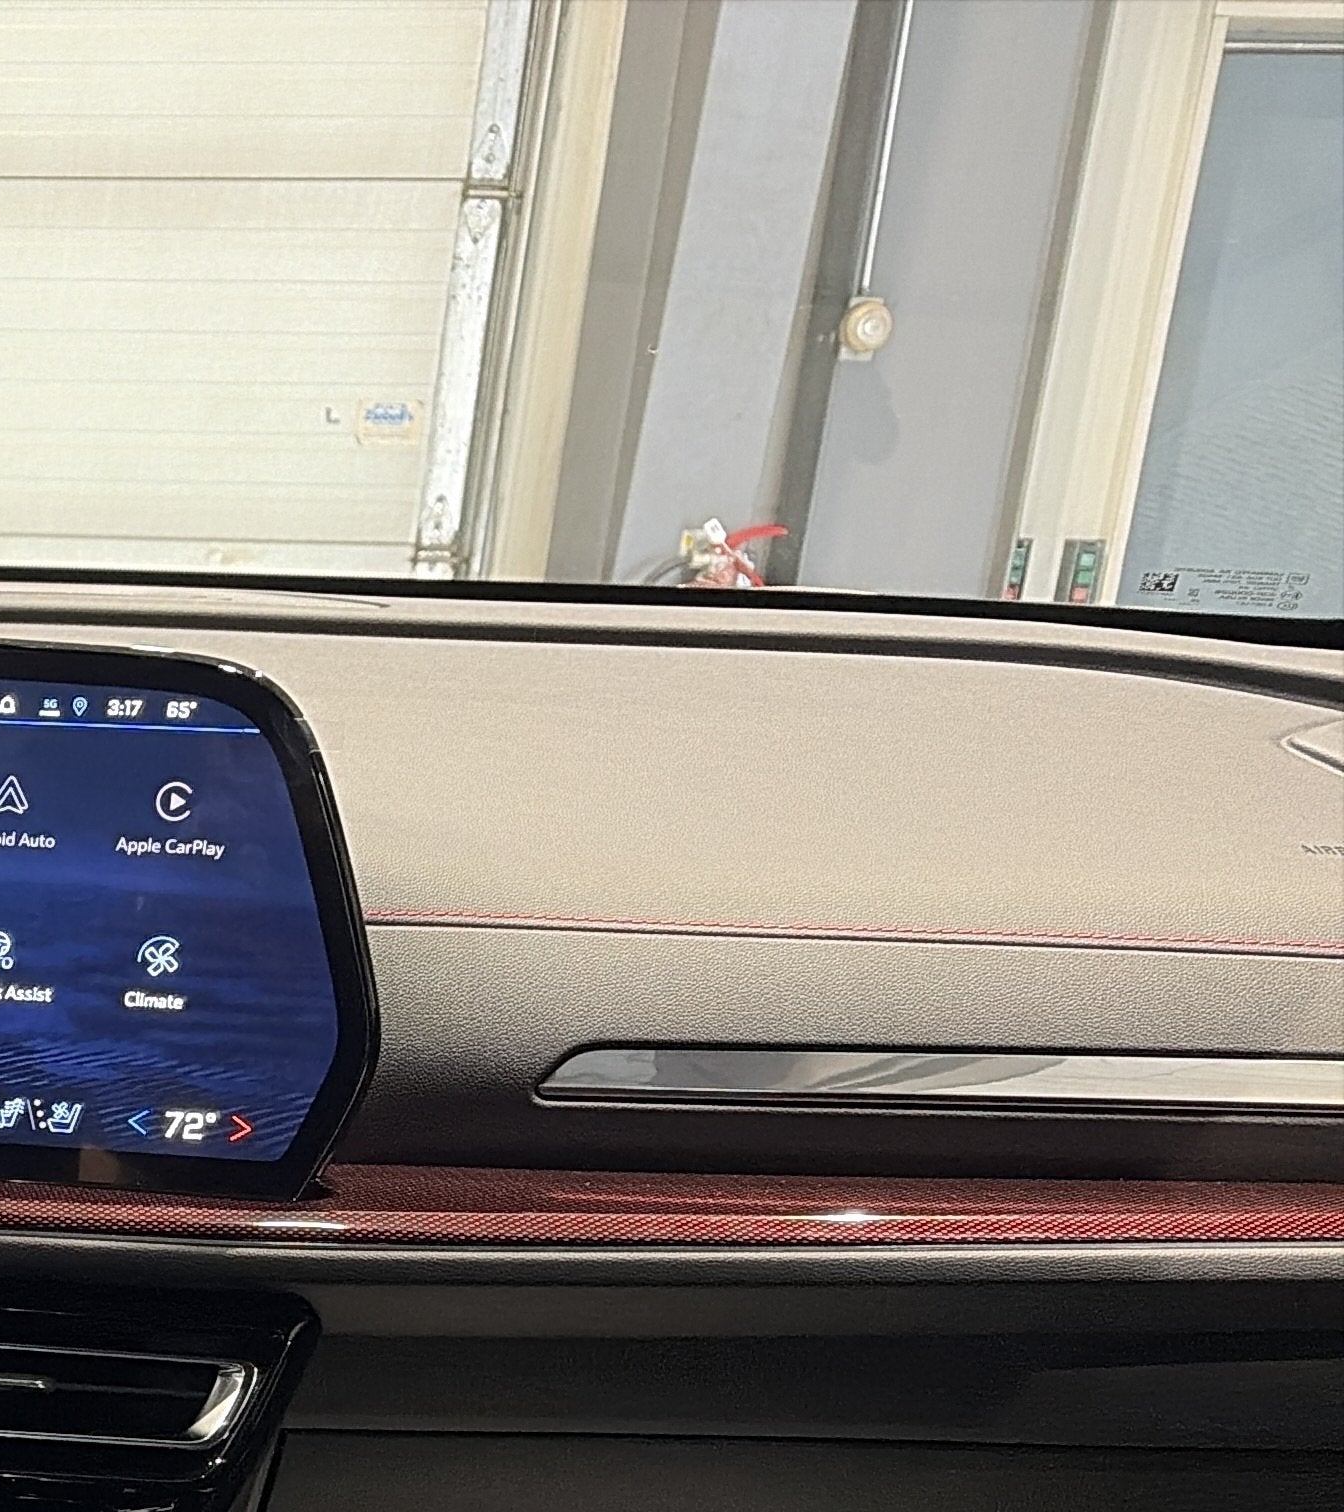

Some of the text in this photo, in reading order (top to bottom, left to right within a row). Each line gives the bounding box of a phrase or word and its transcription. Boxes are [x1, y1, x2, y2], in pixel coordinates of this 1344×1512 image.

[43, 698, 58, 709] 5G
[107, 698, 143, 717] 3:17
[166, 701, 198, 718] 65°
[18, 832, 56, 849] Auto
[115, 837, 225, 859] Apple CarPlay
[5, 985, 53, 1003] Assist
[123, 990, 184, 1010] Climate
[164, 1110, 217, 1141] 72°
